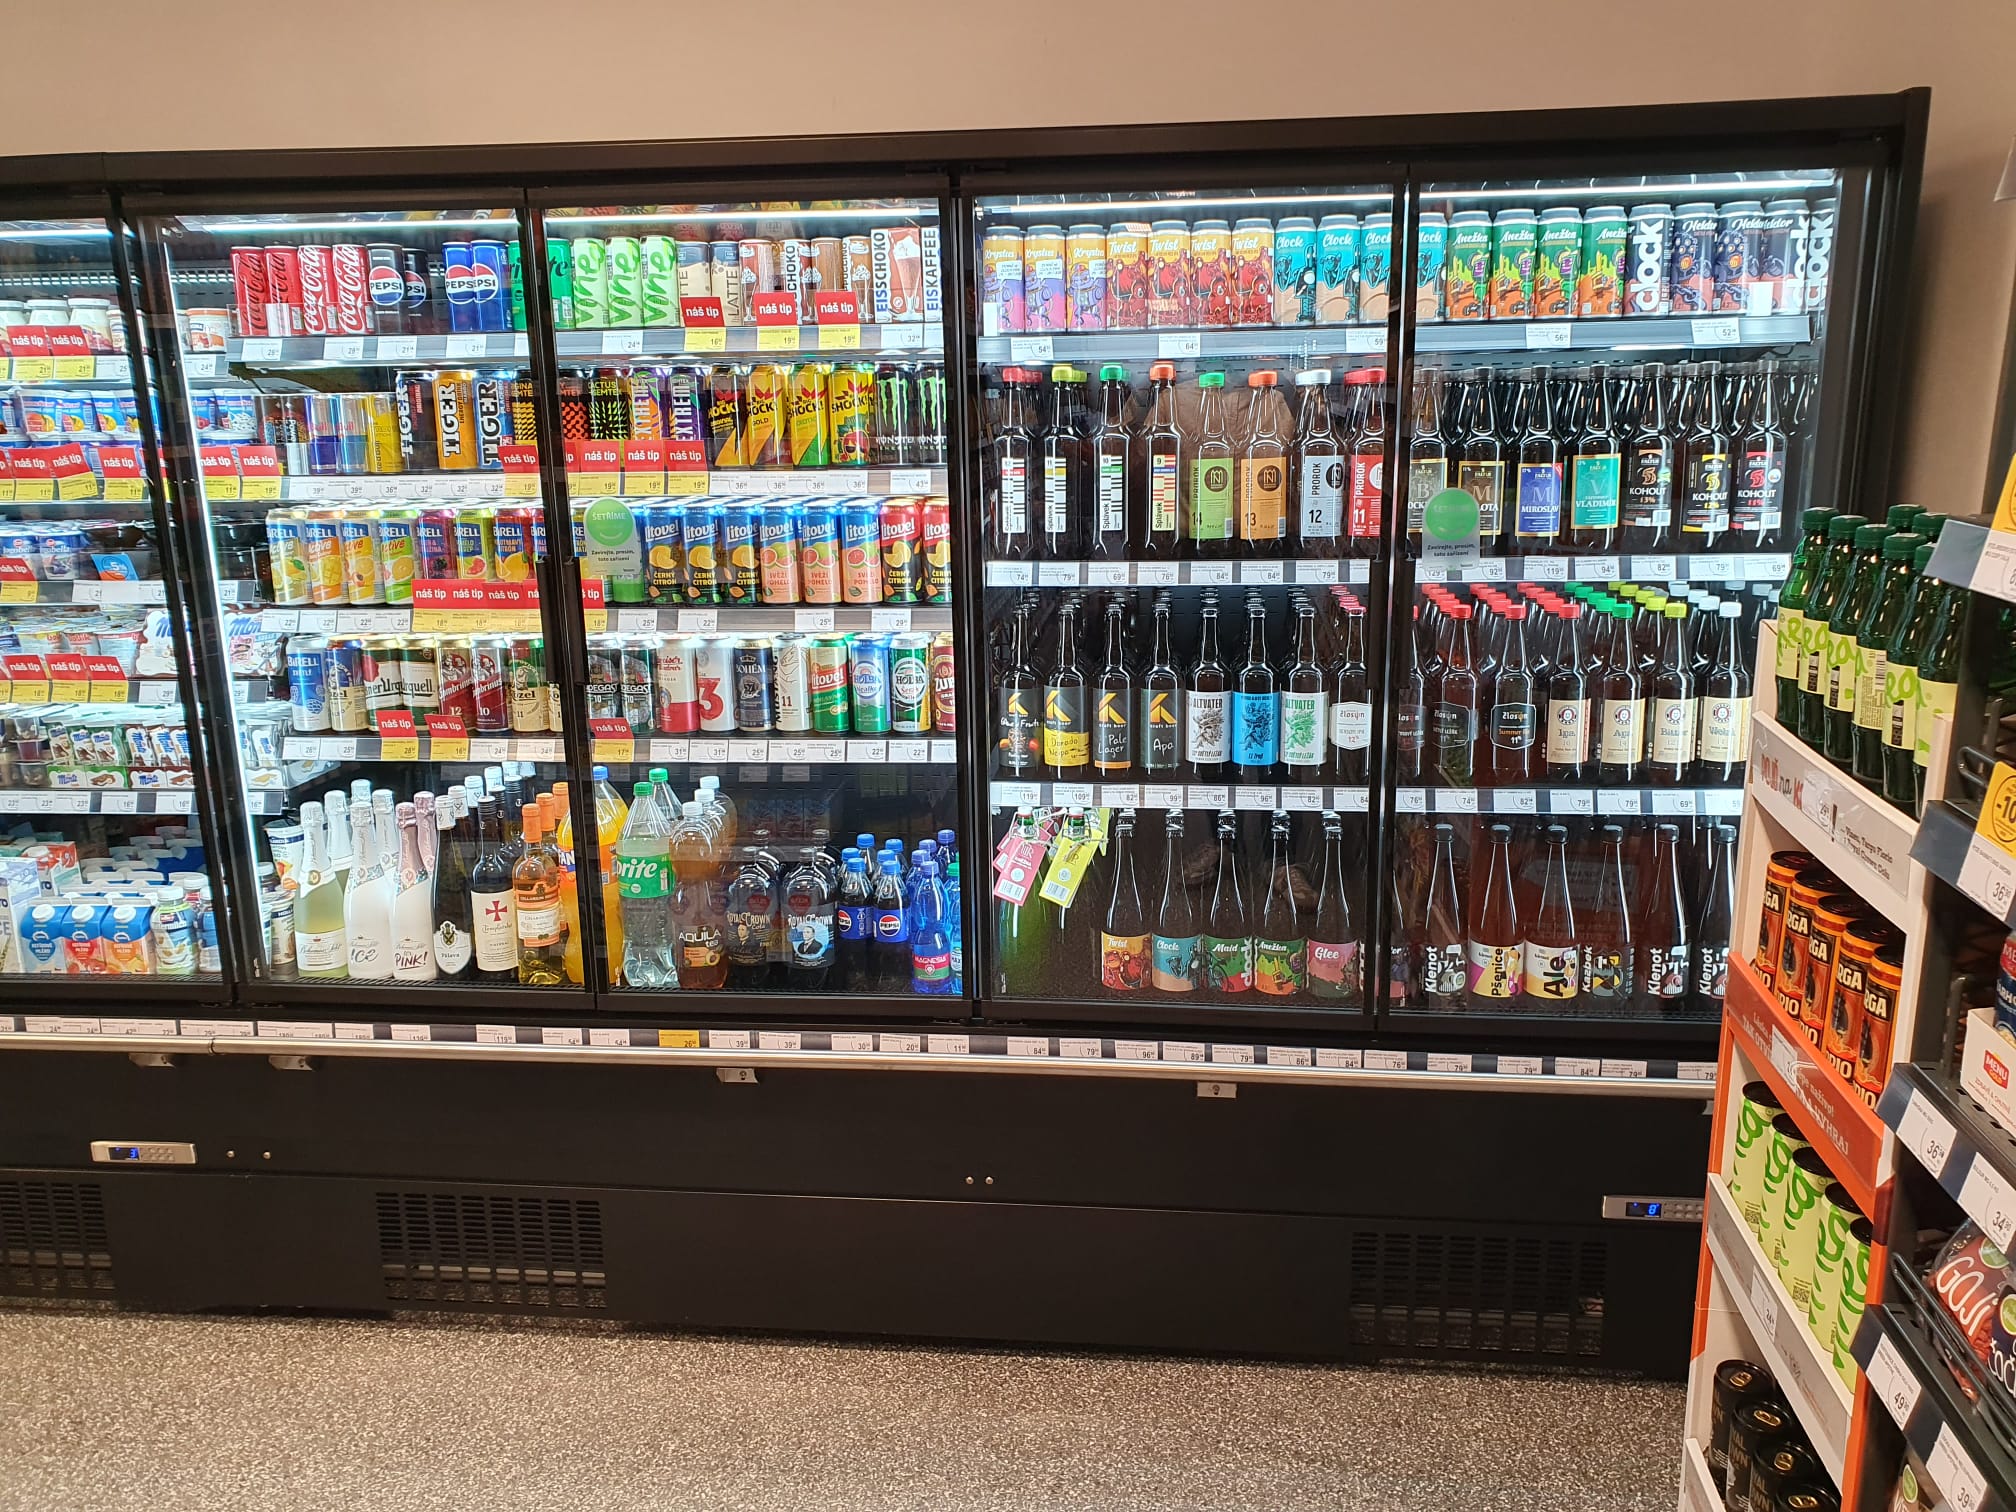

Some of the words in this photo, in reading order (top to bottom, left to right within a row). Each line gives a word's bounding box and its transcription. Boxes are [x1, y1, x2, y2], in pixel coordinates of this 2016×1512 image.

[1109, 241, 1137, 252] Twist
[1151, 240, 1179, 251] Twist
[1191, 239, 1216, 250] Twist
[1276, 237, 1304, 249] Clock
[1322, 234, 1353, 247] Clock
[874, 232, 888, 312] EISSCHOKO
[925, 229, 938, 311] EISKAFFEE
[727, 270, 739, 317] LATTE
[686, 307, 704, 316] náš
[706, 306, 720, 318] tip
[759, 305, 776, 314] náš
[780, 304, 792, 316] tip
[820, 303, 838, 313] náš
[840, 302, 854, 314] tip
[436, 383, 462, 457] TIGER
[475, 379, 500, 466] TIGER
[504, 455, 521, 464] náš
[522, 454, 536, 465] tip
[584, 451, 601, 461] náš
[603, 451, 616, 462] tip
[628, 451, 645, 461] náš
[646, 450, 660, 462] tip
[670, 451, 686, 461] náš
[687, 451, 701, 462] tip
[15, 457, 31, 468] náš
[33, 457, 45, 470] tip
[104, 457, 120, 468] náš
[121, 457, 134, 469] tip
[243, 457, 261, 467] náš
[262, 457, 274, 468] tip
[1312, 462, 1321, 496] PROROK
[1356, 462, 1365, 496] PROROK
[1693, 493, 1728, 501] KOHOUT
[1737, 490, 1776, 498] KOHOUT
[1521, 505, 1559, 513] MIROSLAV
[1309, 510, 1322, 523] 12
[1353, 509, 1365, 523] 11
[760, 520, 793, 540] Litovel
[803, 520, 835, 540] Litovel
[846, 519, 879, 540] Litovel
[882, 518, 915, 539] Litovel
[416, 589, 433, 598] náš
[434, 589, 446, 600] tip
[453, 589, 470, 598] náš
[471, 588, 483, 600] tip
[489, 591, 505, 600] náš
[506, 590, 519, 600] tip
[812, 671, 844, 689] Litovel
[855, 674, 882, 684] HOLBA
[896, 674, 925, 684] HOLBA
[700, 677, 724, 720] 3
[782, 696, 793, 706] 11
[1193, 699, 1223, 709] ALTVATER
[450, 706, 462, 716] 12
[480, 706, 489, 716] 10
[1285, 700, 1315, 710] ALTVATER
[382, 720, 398, 728] náš
[400, 720, 411, 729] tip
[431, 722, 448, 730] náš
[449, 722, 461, 732] tip
[1108, 734, 1127, 744] Pale
[1153, 738, 1173, 756] Apa
[1157, 940, 1179, 951] Clock
[395, 951, 427, 967] PINK!
[1315, 947, 1338, 960] Glee
[1425, 946, 1437, 992] Klenot
[1492, 949, 1503, 996] Pšenice
[1582, 945, 1592, 992] Kazbek
[1648, 947, 1662, 995] Klenot
[1699, 947, 1713, 995] Klenot
[1544, 956, 1566, 997] Ale
[1985, 1054, 2008, 1082] MENU
[1648, 1205, 1657, 1215] 8
[1936, 1256, 1999, 1336] GOJI
